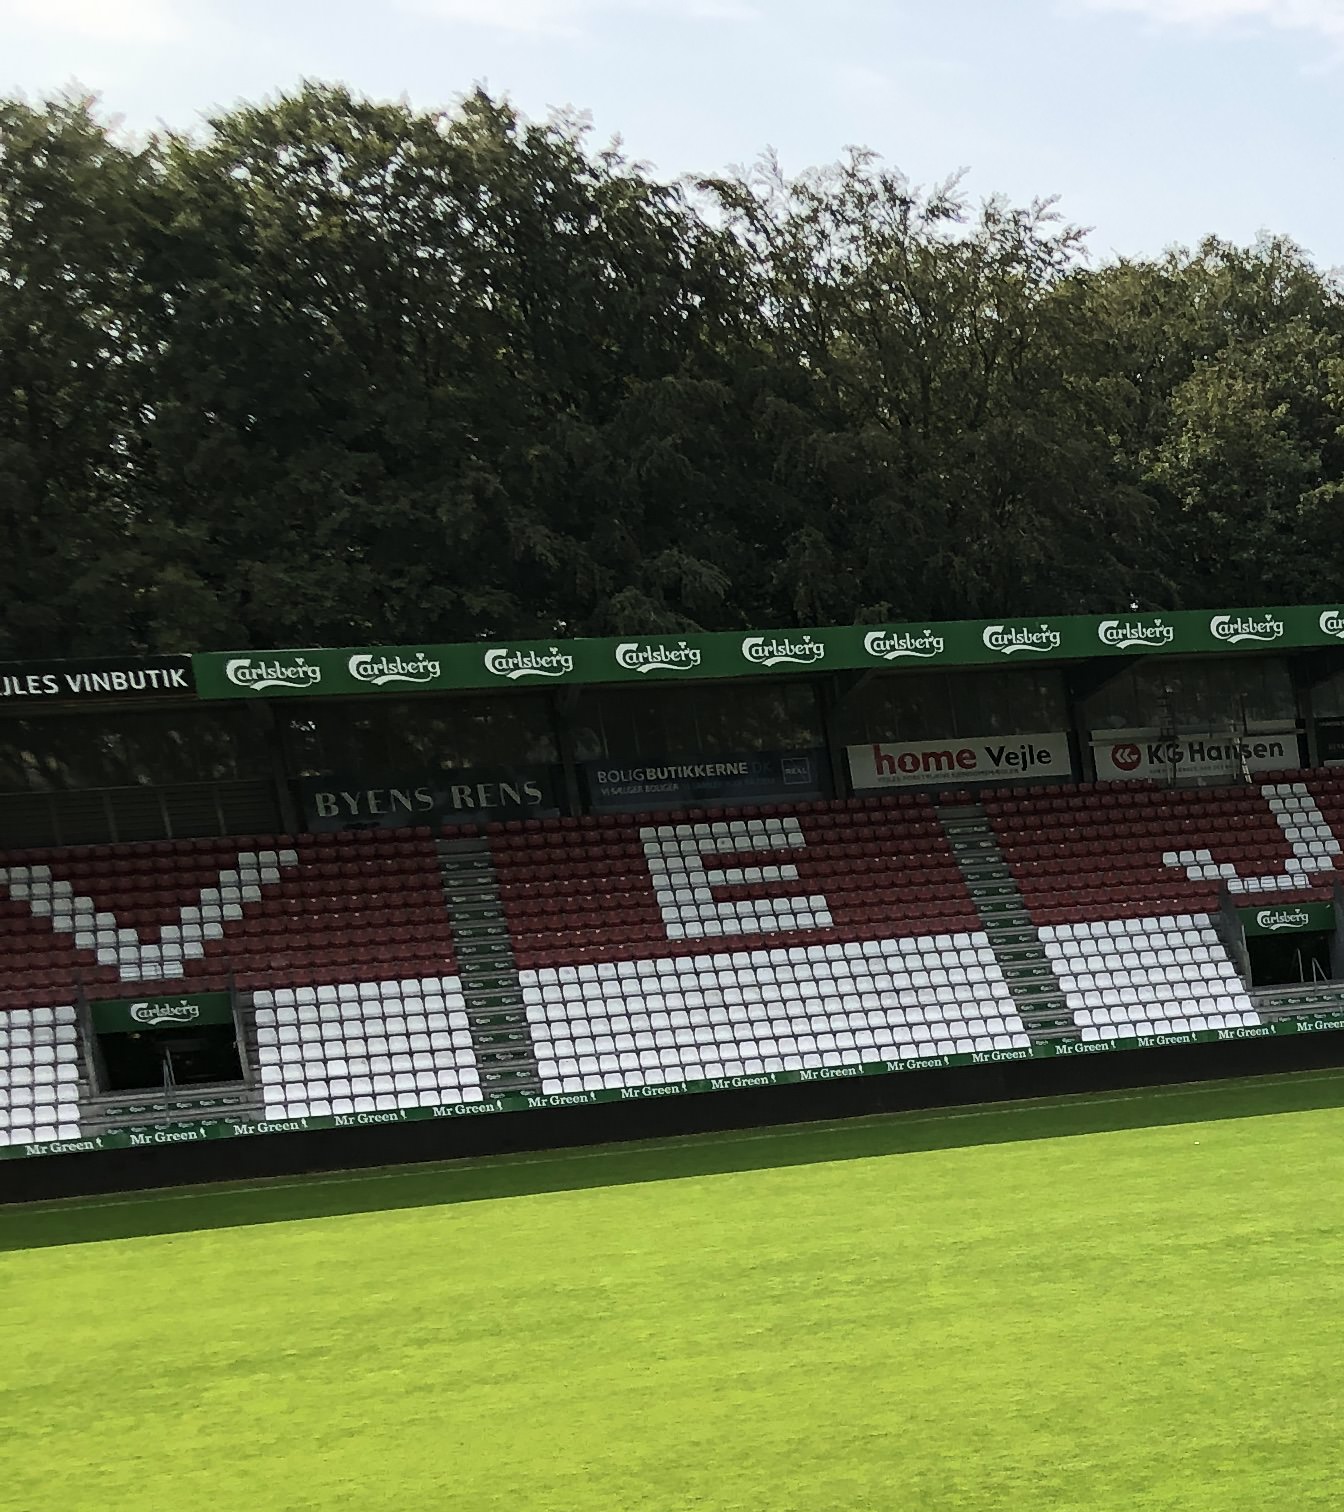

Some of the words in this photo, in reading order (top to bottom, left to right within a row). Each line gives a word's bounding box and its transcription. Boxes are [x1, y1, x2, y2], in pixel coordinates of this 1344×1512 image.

[982, 624, 1061, 654] Carlsberg
[1098, 619, 1174, 649] Carlsberg
[1210, 614, 1283, 643] Carlsberg
[742, 636, 824, 667] Carlsberg
[864, 630, 944, 660] Carlsberg
[349, 653, 440, 685] Carlsberg
[484, 647, 573, 680] Carlsberg
[615, 642, 701, 673] Carlsberg
[0, 674, 59, 697] JLES
[64, 668, 189, 693] VINBUTIK
[226, 658, 321, 690] Carlsberg
[872, 744, 977, 776] home
[984, 744, 1052, 772] Vejle
[1188, 741, 1285, 764] Hansen
[314, 786, 434, 817] BYENS
[451, 780, 543, 809] RENS
[1256, 908, 1310, 931] Carlsberg
[130, 1000, 200, 1025] Carlsberg
[1138, 1037, 1153, 1047] Mr
[1155, 1034, 1190, 1045] Green
[800, 1070, 818, 1080] Mr
[820, 1067, 856, 1078] Green
[887, 1061, 905, 1072] Mr
[907, 1058, 942, 1069] Green
[621, 1088, 640, 1099] Mr
[642, 1085, 680, 1096] Green
[711, 1079, 730, 1090] Mr
[731, 1076, 769, 1087] Green
[433, 1106, 453, 1117] Mr
[455, 1103, 494, 1114] Green
[528, 1097, 547, 1108] Mr
[549, 1094, 589, 1105] Green
[233, 1124, 255, 1135] Mr
[257, 1121, 299, 1132] Green
[334, 1115, 355, 1126] Mr
[357, 1112, 398, 1124] Green
[26, 1144, 48, 1156] Mr
[50, 1140, 94, 1153] Green
[130, 1134, 152, 1145] Mr
[155, 1130, 197, 1142] Green
